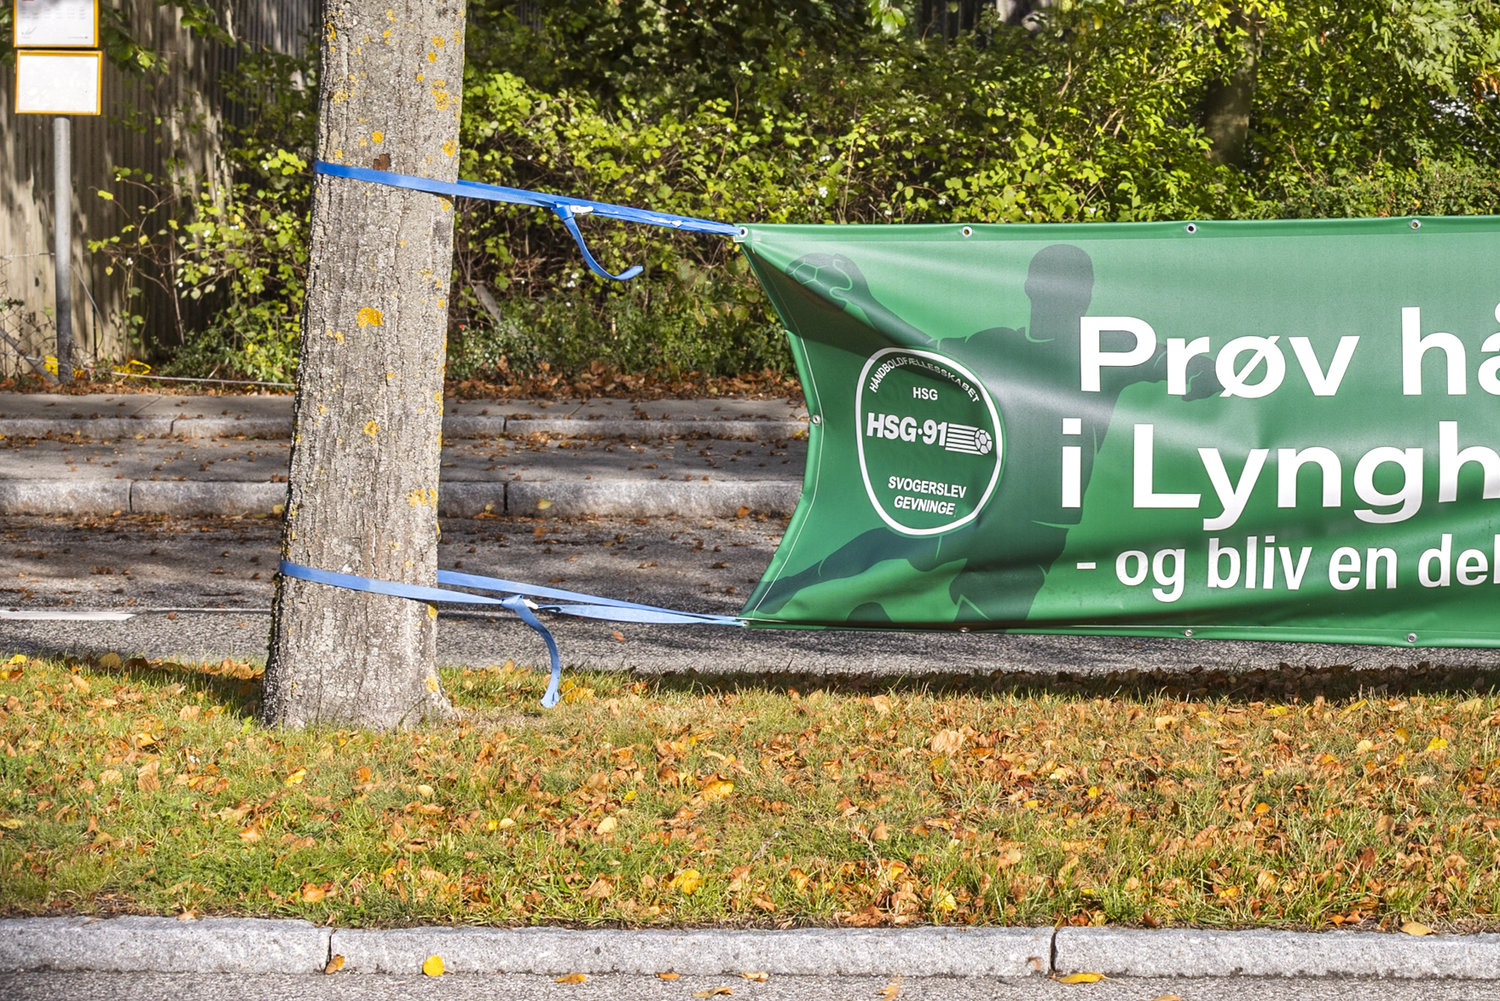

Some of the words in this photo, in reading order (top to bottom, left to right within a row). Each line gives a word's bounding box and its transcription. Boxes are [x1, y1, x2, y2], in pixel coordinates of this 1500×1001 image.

[868, 356, 980, 403] HANDBOLDFÆLLESSKABET
[1079, 315, 1361, 399] Prøv
[912, 386, 938, 401] HSG
[1061, 417, 1083, 508] i
[887, 475, 967, 499] SVOGERSLEV
[893, 495, 956, 516] GEVNINGE
[1076, 561, 1097, 570] -
[1115, 547, 1186, 603] og
[1207, 535, 1313, 590] bliv
[1328, 546, 1398, 590] en
